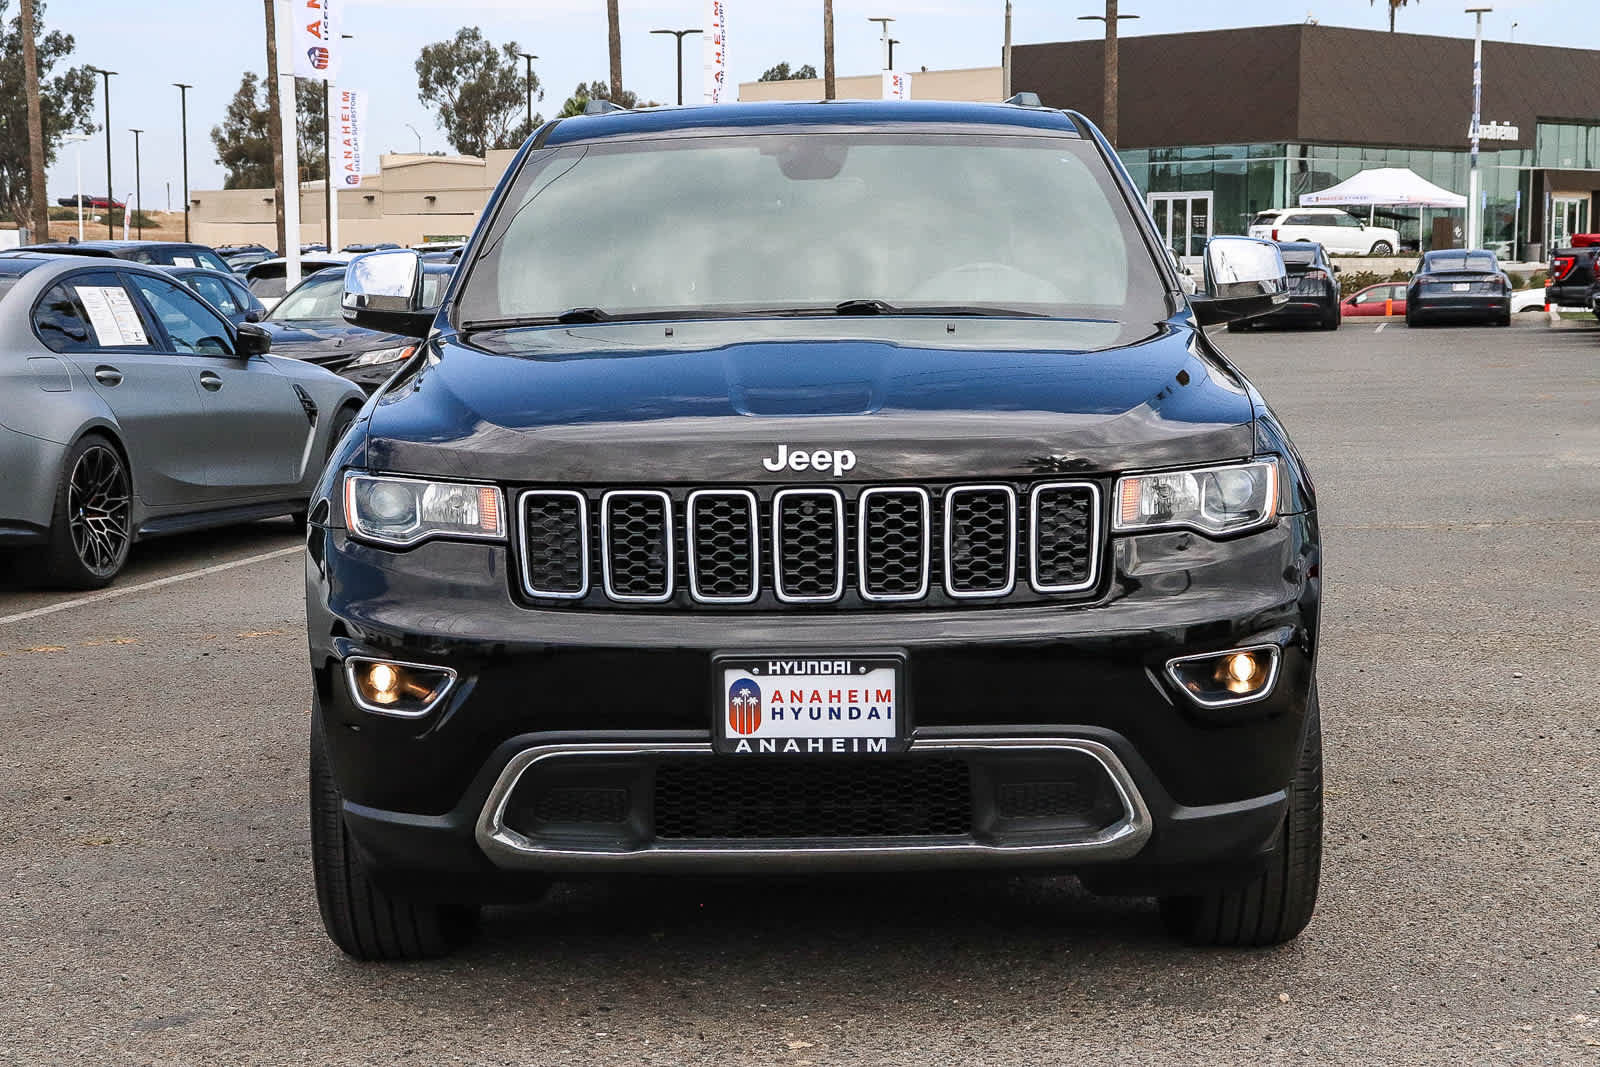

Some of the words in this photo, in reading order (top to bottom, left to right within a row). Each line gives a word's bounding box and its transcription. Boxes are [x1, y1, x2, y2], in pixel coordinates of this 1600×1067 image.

[341, 91, 353, 172] ANAHEIM
[763, 444, 857, 477] Jeep
[768, 661, 851, 675] HYUNDAI
[771, 689, 892, 703] ANAHEIM
[771, 706, 892, 720] HYUNDAI
[735, 738, 888, 753] ANAHEIM
